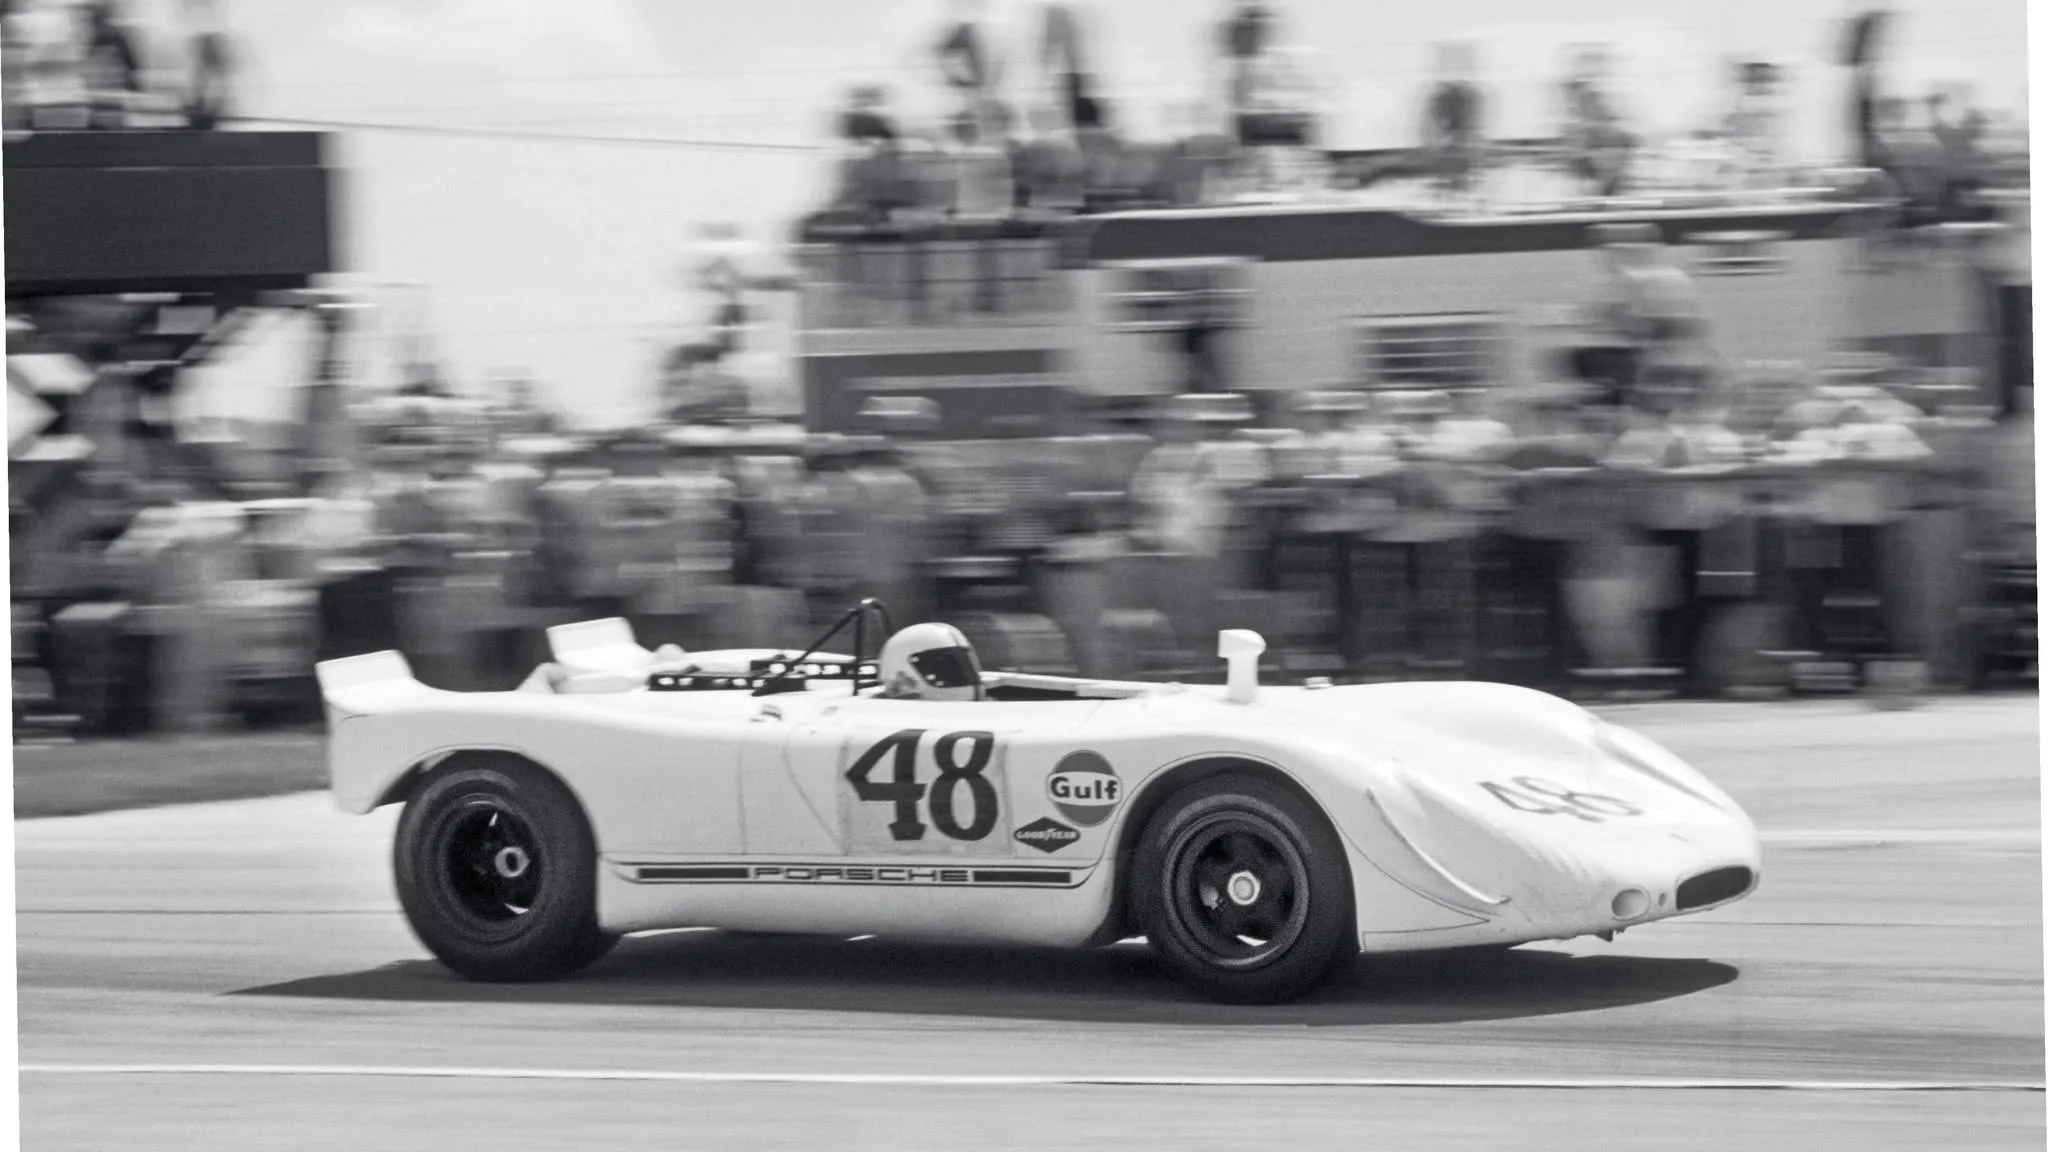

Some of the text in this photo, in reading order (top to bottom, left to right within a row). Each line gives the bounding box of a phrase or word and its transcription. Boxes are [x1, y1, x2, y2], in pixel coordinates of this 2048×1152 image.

[845, 729, 999, 841] 48
[1051, 776, 1118, 800] Gulf
[1477, 776, 1644, 823] 48
[755, 867, 969, 882] PORSCHE
